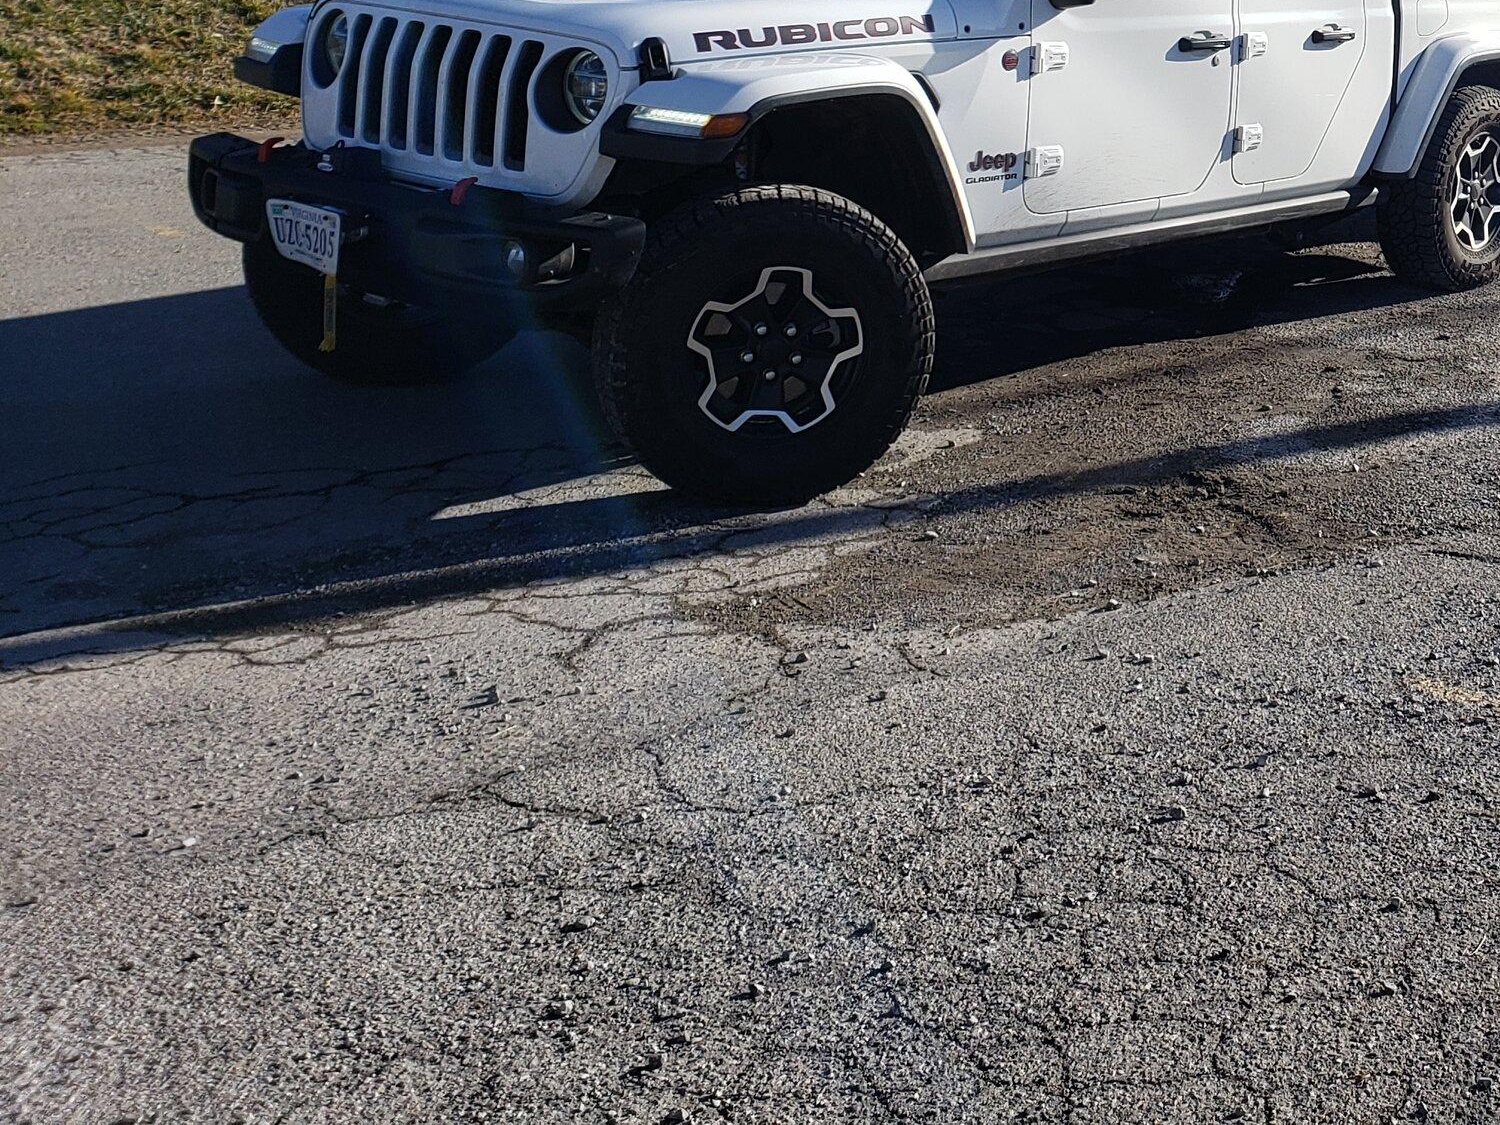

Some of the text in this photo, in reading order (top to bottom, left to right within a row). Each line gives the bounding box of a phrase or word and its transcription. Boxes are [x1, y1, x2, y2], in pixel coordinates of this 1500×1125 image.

[693, 14, 935, 52] RUBICON
[969, 150, 1016, 172] Jeep
[965, 173, 1017, 184] GLADIATOR
[290, 206, 324, 225] VIRGINIA
